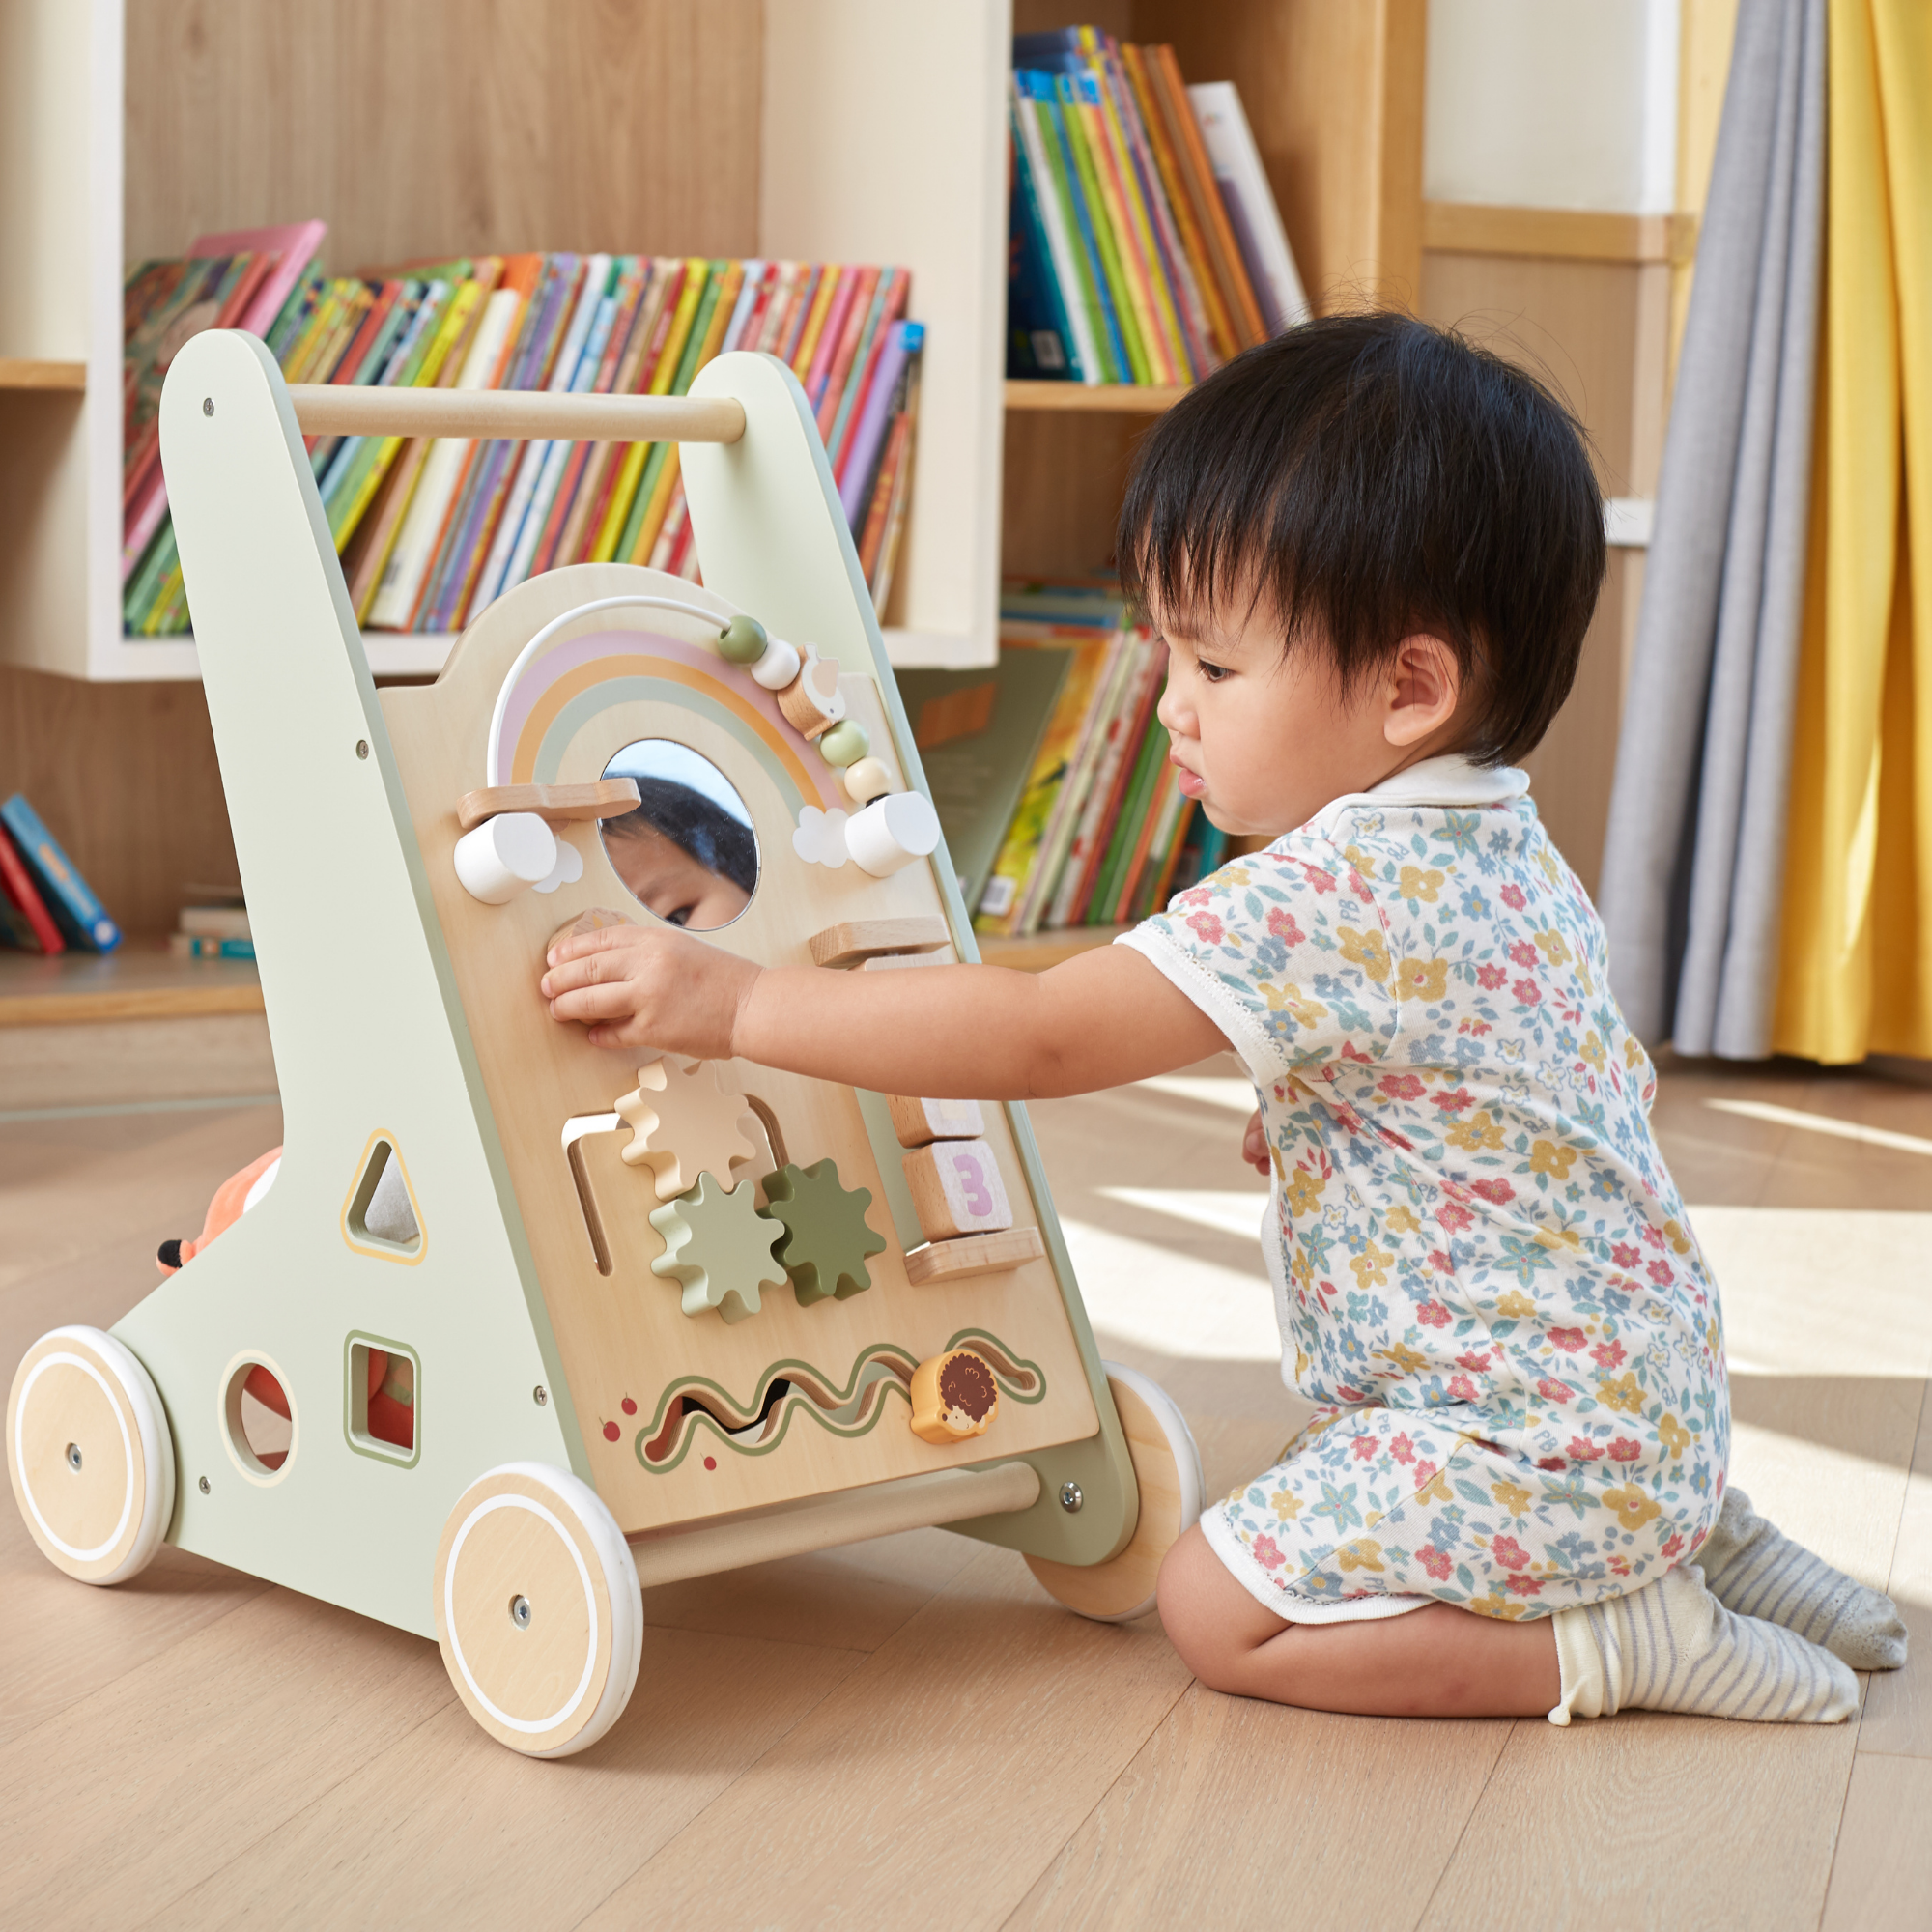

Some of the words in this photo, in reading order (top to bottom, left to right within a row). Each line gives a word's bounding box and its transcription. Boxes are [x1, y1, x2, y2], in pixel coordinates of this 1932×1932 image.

[1387, 842, 1410, 861] PB
[1338, 899, 1361, 923] PB
[1523, 1117, 1551, 1134] PB
[952, 1153, 993, 1217] 3
[1662, 1385, 1678, 1407] PB
[1377, 1413, 1391, 1435] PB
[1533, 1430, 1558, 1452] PB
